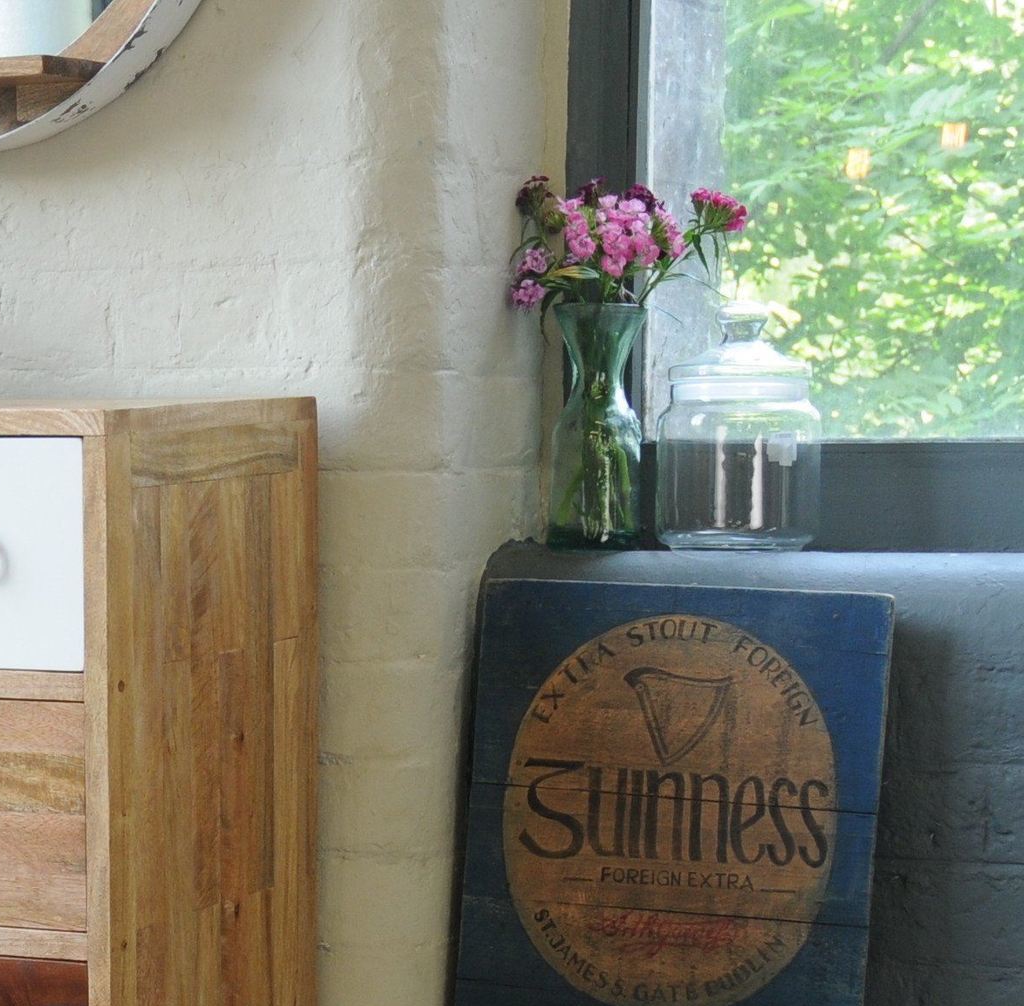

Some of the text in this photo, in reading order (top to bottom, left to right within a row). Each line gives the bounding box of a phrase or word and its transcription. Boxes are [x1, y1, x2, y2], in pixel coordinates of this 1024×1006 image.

[531, 619, 819, 728] EXTRA STOUT FOREIGN
[600, 866, 755, 892] FOREIGN EXTRA
[633, 980, 699, 1001] GATE
